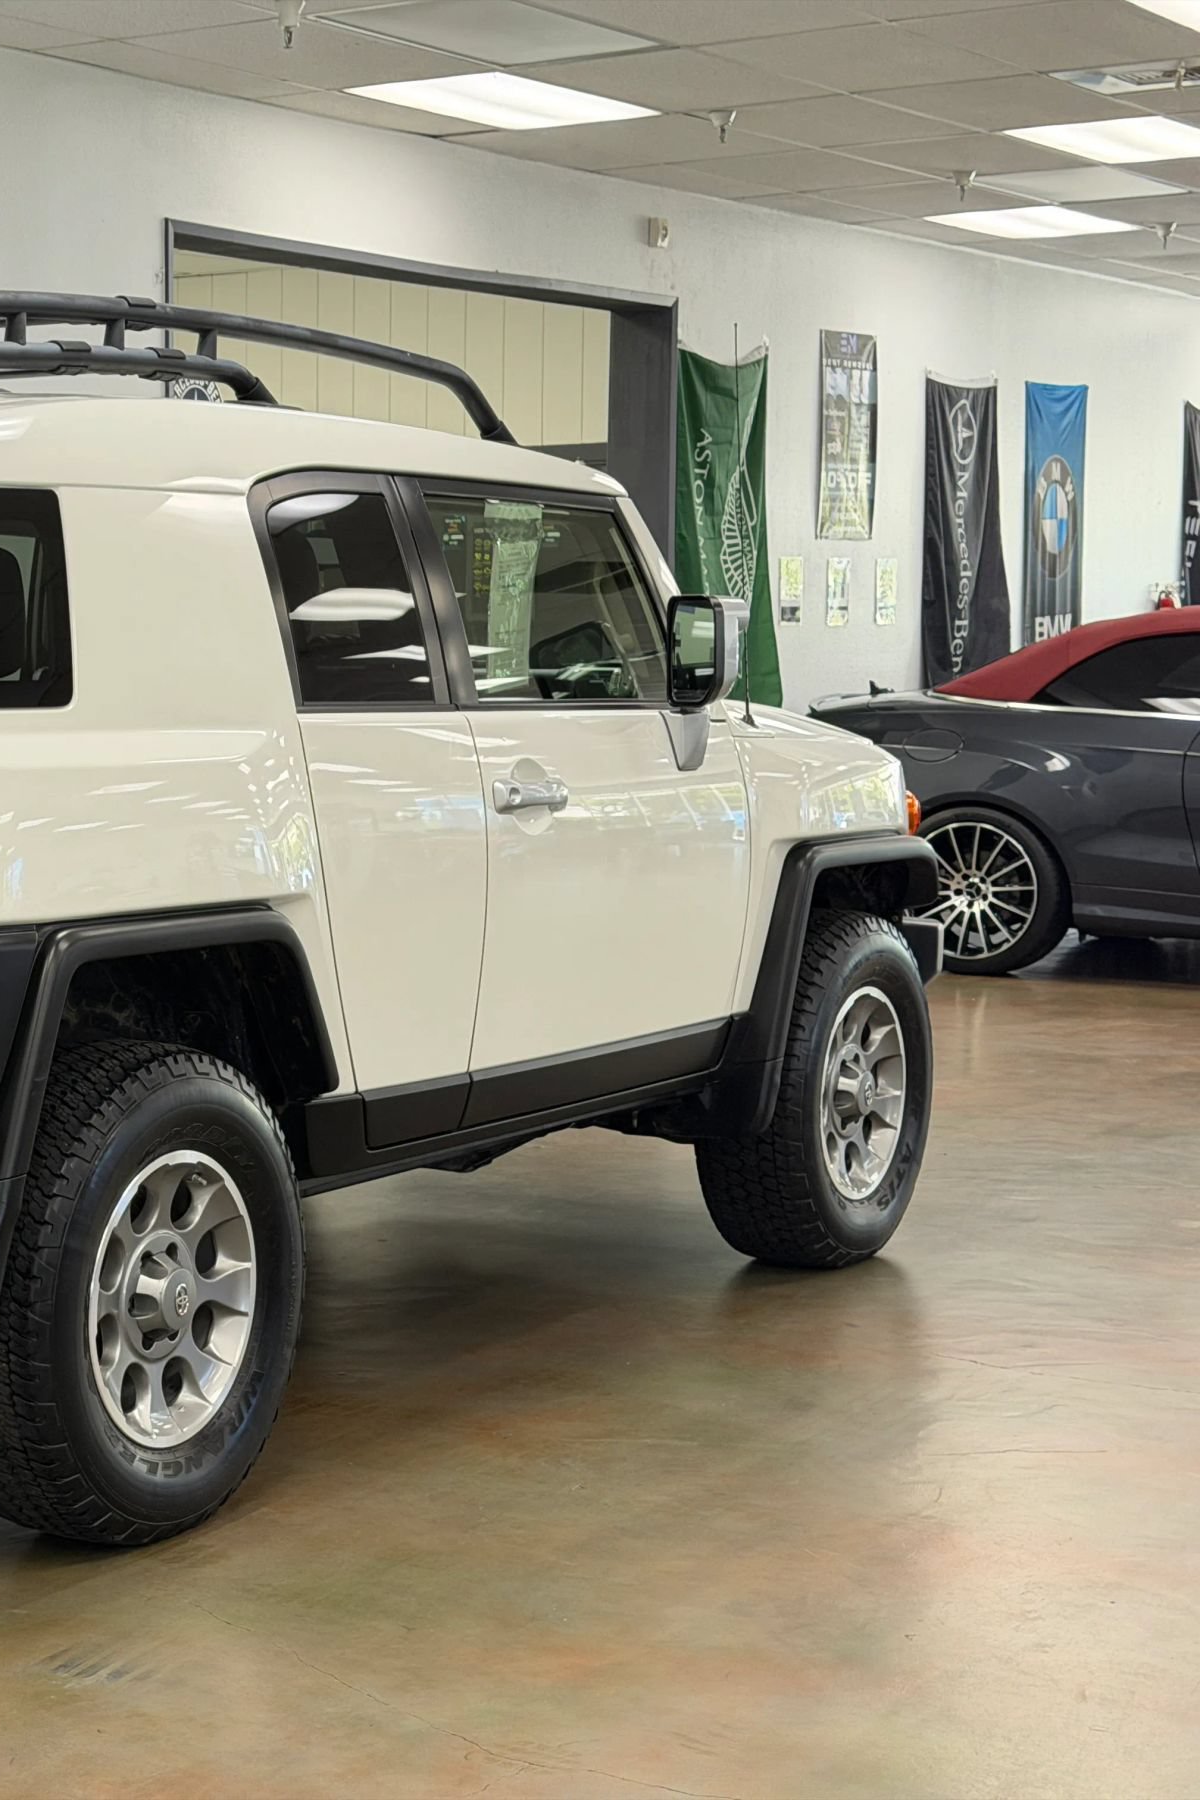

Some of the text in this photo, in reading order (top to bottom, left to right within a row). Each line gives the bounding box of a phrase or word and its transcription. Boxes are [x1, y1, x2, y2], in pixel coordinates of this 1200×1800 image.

[693, 428, 713, 525] ASTON
[951, 471, 972, 677] Mercedes-Ben
[1035, 613, 1072, 643] BMW
